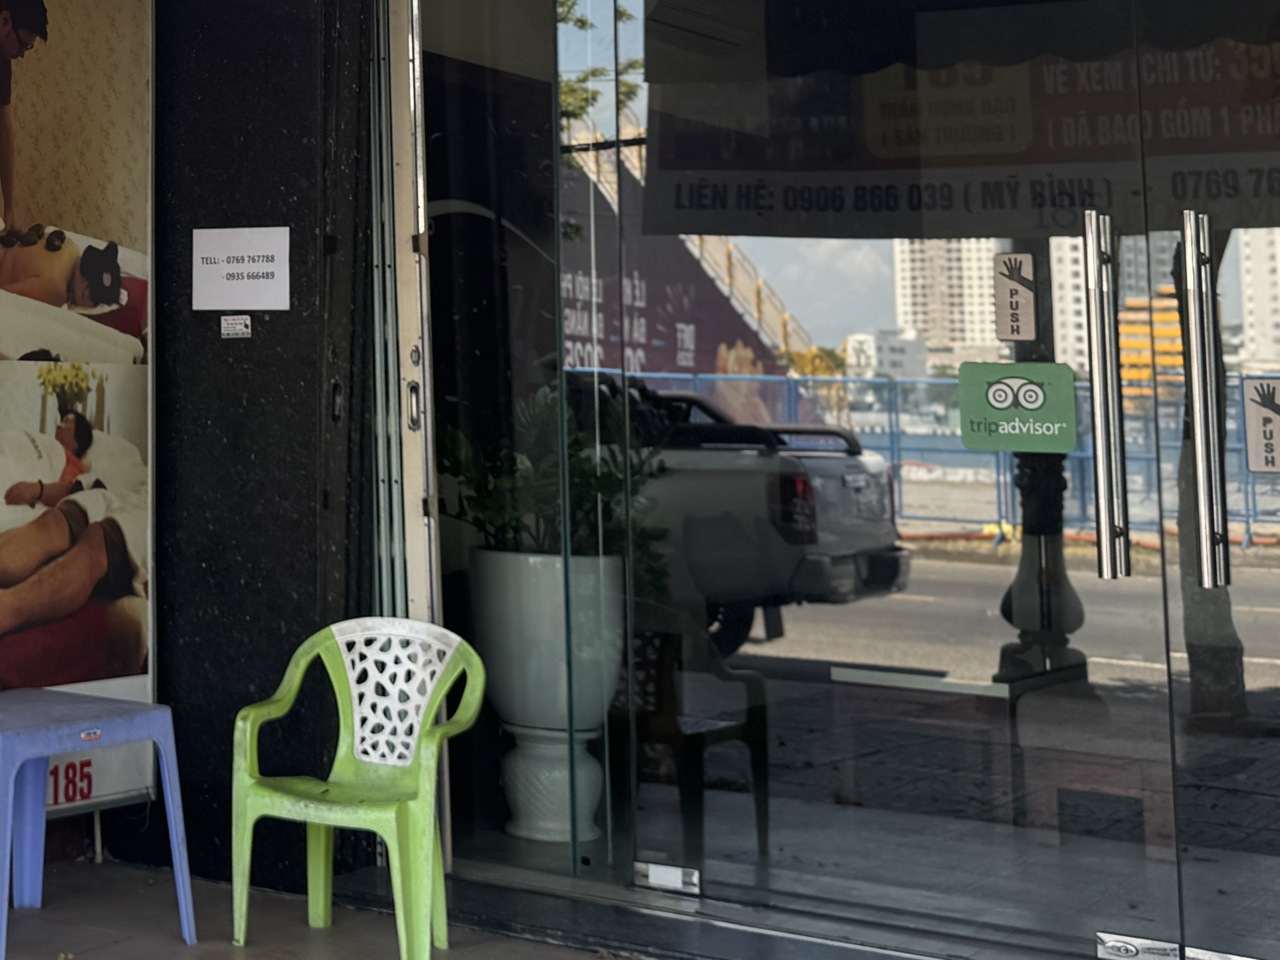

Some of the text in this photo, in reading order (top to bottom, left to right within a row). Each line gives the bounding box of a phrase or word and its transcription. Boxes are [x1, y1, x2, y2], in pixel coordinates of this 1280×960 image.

[782, 184, 845, 212] 0906
[852, 184, 898, 212] 866
[200, 256, 220, 265] TELL:
[225, 255, 246, 265] 0769
[247, 254, 276, 264] 767788
[225, 271, 245, 281] 0935
[246, 271, 275, 281] 666489
[1009, 288, 1020, 335] PUSH
[1262, 416, 1276, 467] PUSH
